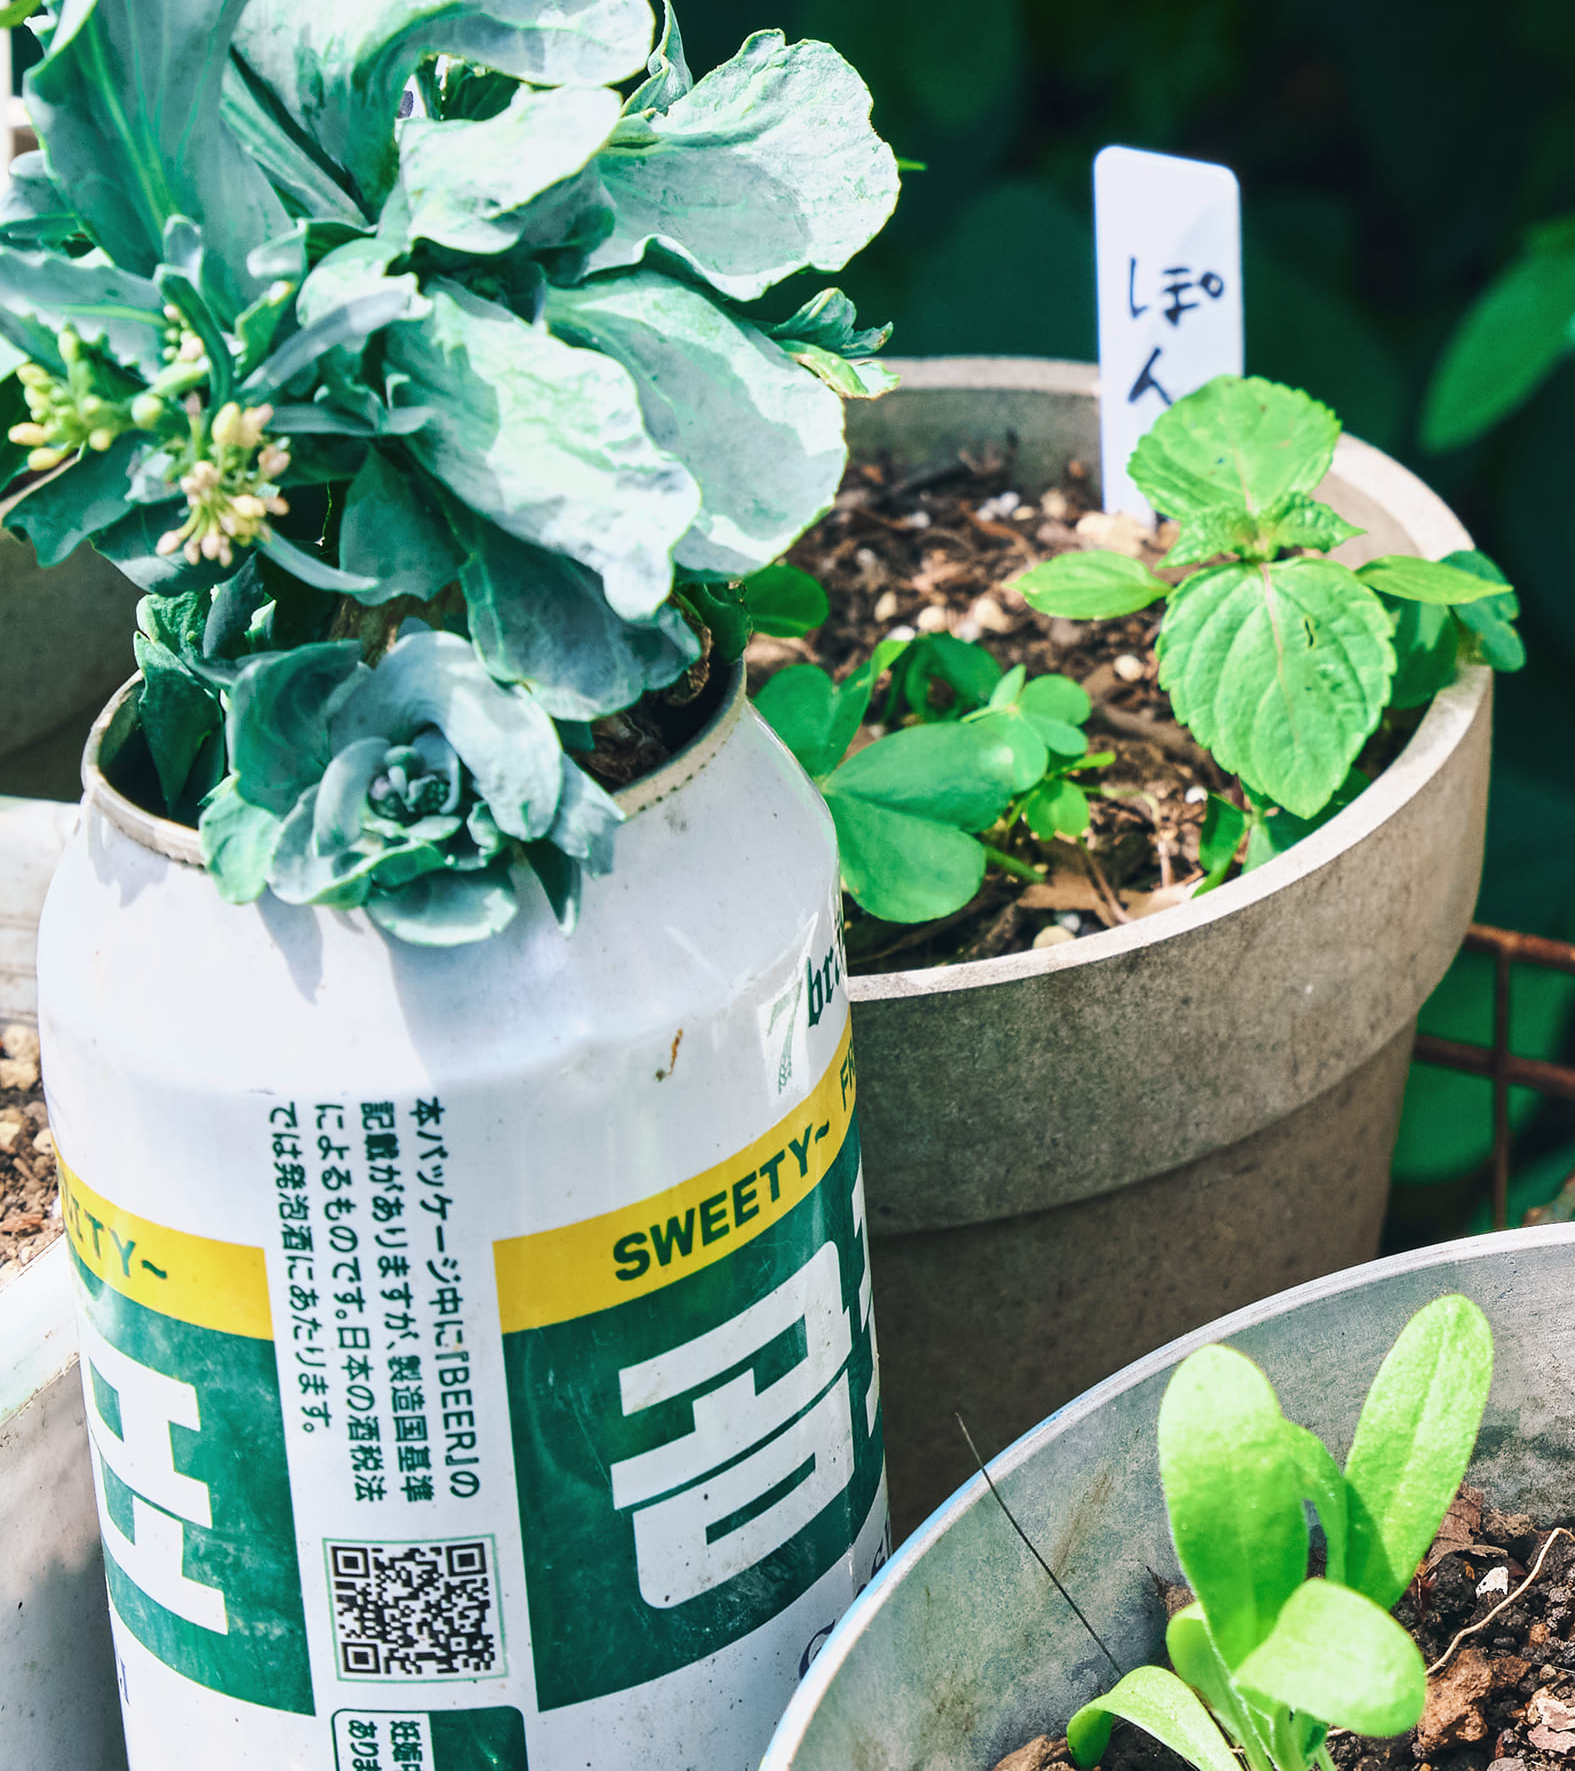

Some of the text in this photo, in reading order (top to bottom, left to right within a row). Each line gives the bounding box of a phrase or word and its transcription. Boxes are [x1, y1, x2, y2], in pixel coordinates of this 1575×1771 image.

[269, 1101, 333, 1433] では発泡酒にあたります。
[313, 1103, 388, 1503] によるものです。日本の酒税法
[359, 1100, 435, 1503] 記載がありますが、製造国基準
